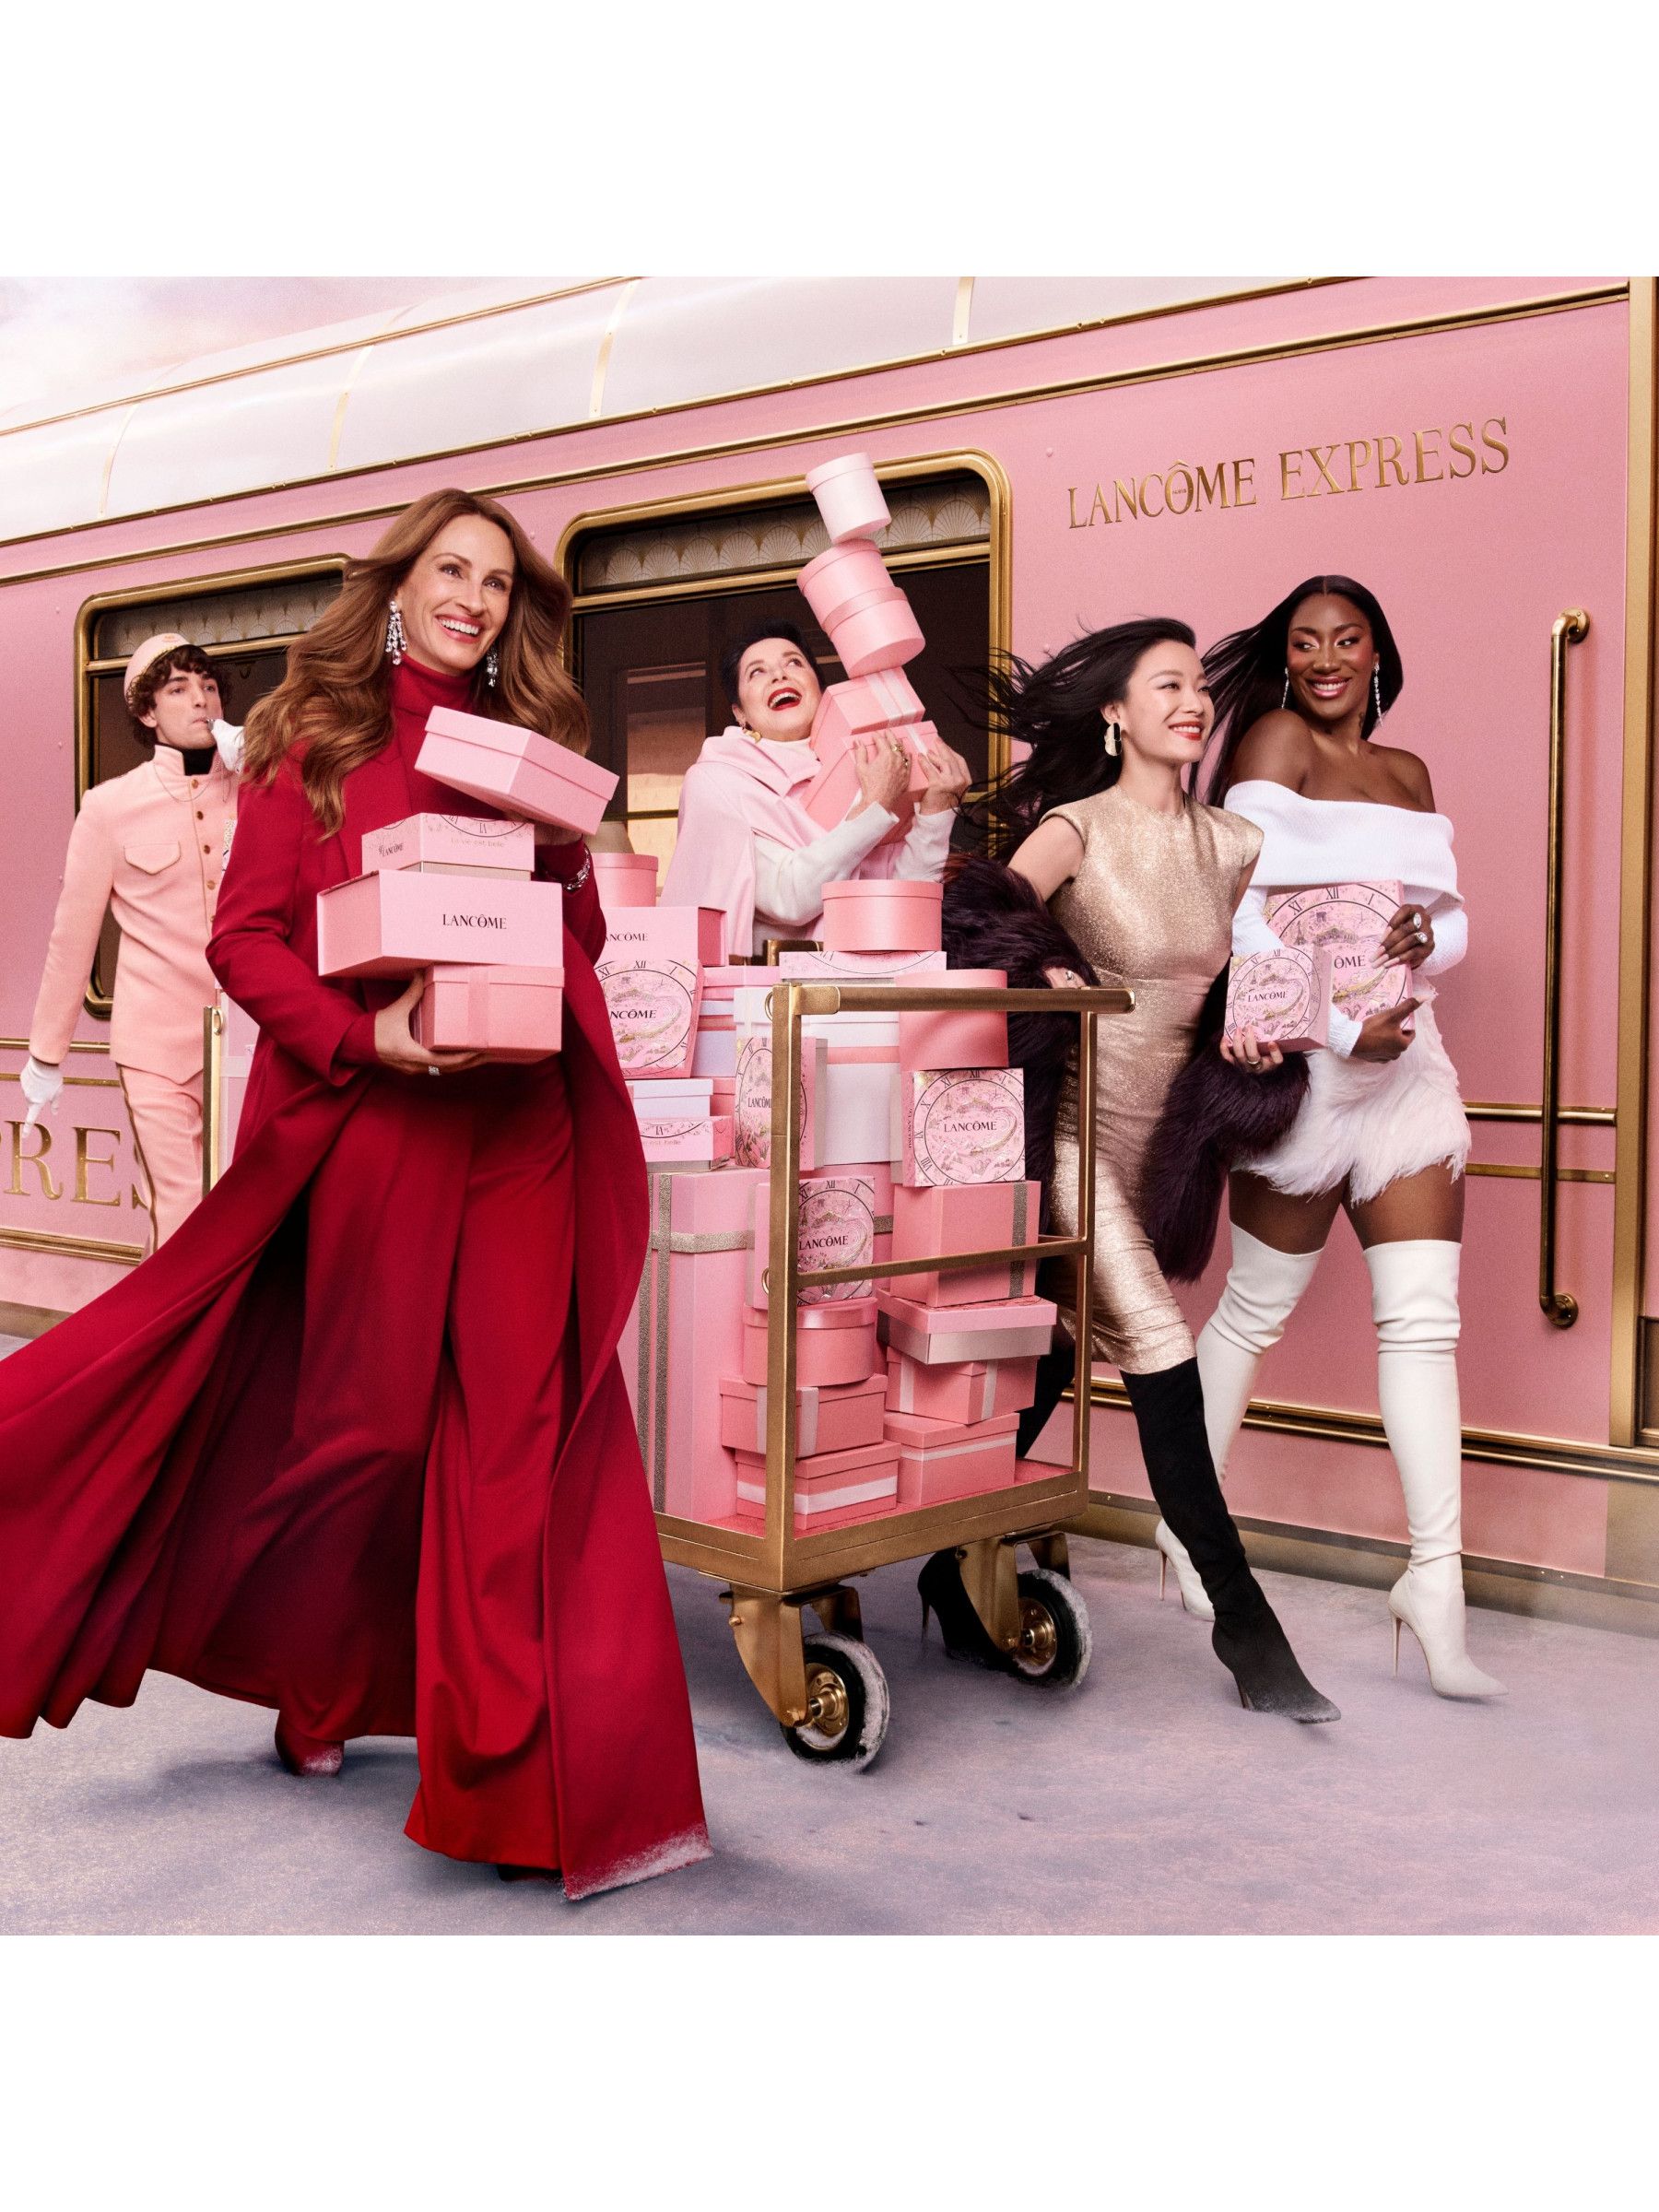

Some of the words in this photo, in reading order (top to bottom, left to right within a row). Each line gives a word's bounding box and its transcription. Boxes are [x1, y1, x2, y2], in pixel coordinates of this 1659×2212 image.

[1068, 458, 1257, 529] LANCÔME
[1278, 416, 1510, 500] EXPRESS
[442, 913, 507, 930] LANCÔME
[606, 931, 648, 942] NCÔME
[1334, 955, 1366, 970] ÔME
[609, 1008, 657, 1020] NCÔME
[747, 1096, 772, 1109] LANCÔM
[943, 1120, 998, 1133] LANCÔME
[798, 1235, 849, 1251] LANCÔME
